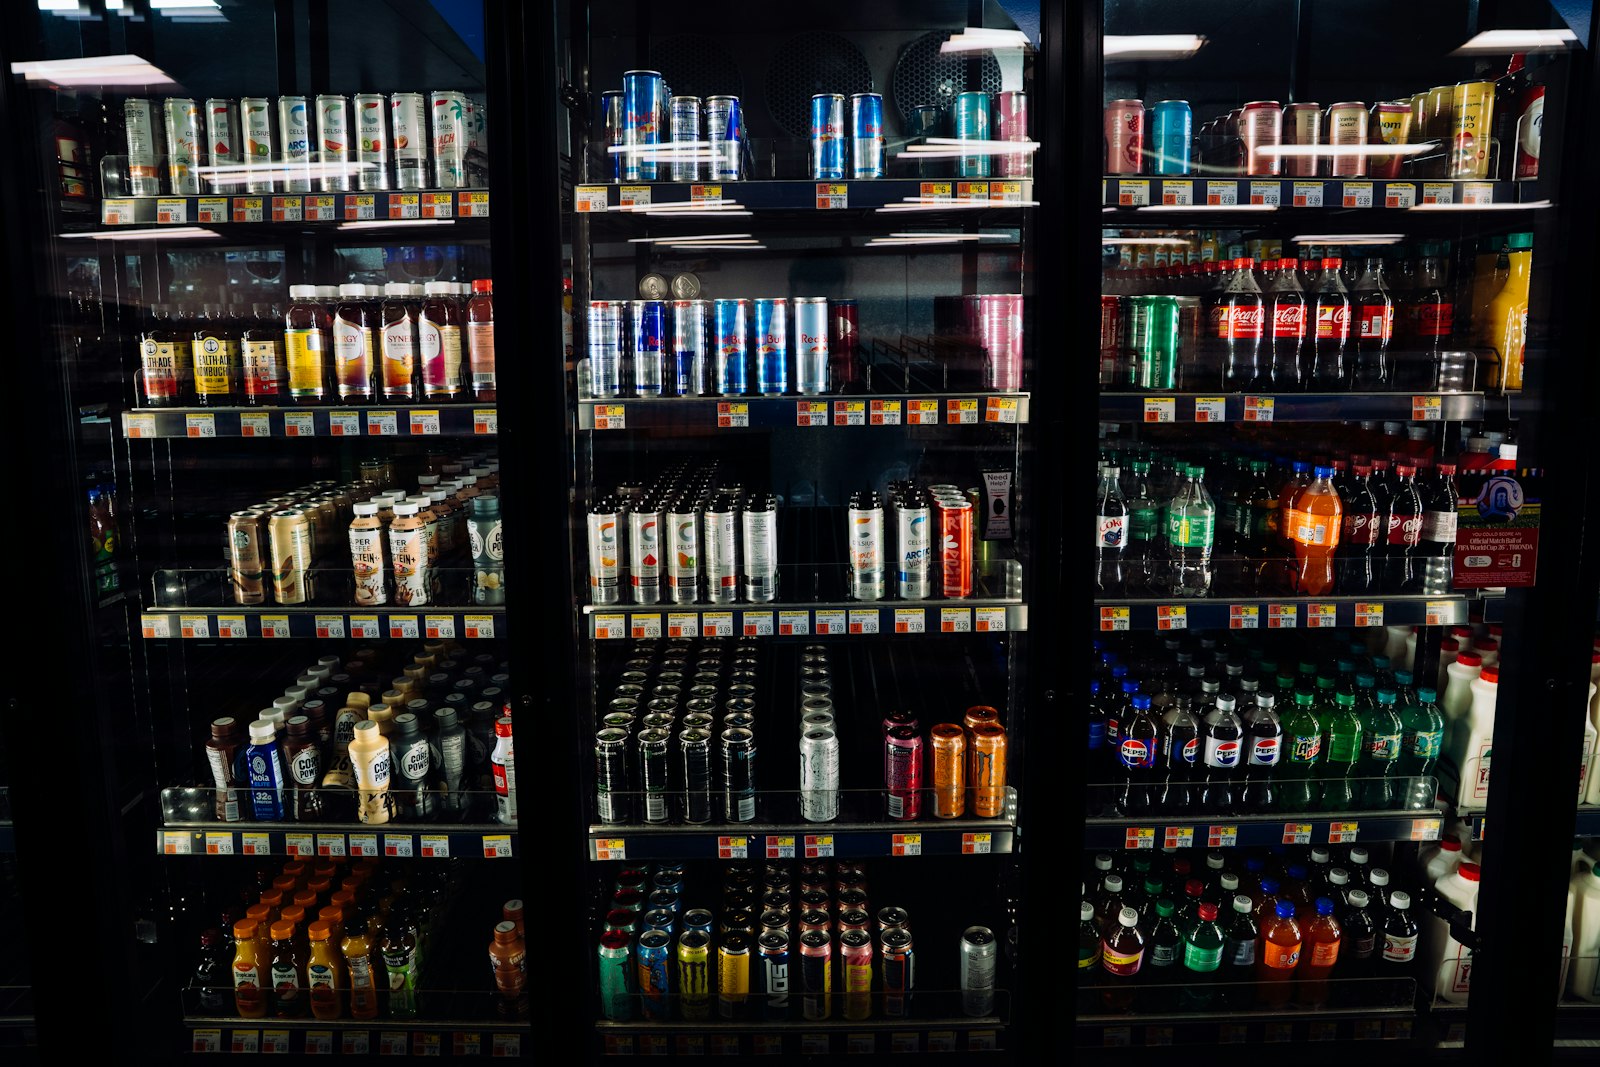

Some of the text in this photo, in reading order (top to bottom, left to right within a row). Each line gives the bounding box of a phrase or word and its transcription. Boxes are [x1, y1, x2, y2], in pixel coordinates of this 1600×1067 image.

[1486, 544, 1498, 552] Cup
[253, 772, 270, 782] koia
[235, 971, 256, 979] Tropicana
[310, 972, 332, 980] Tropicana
